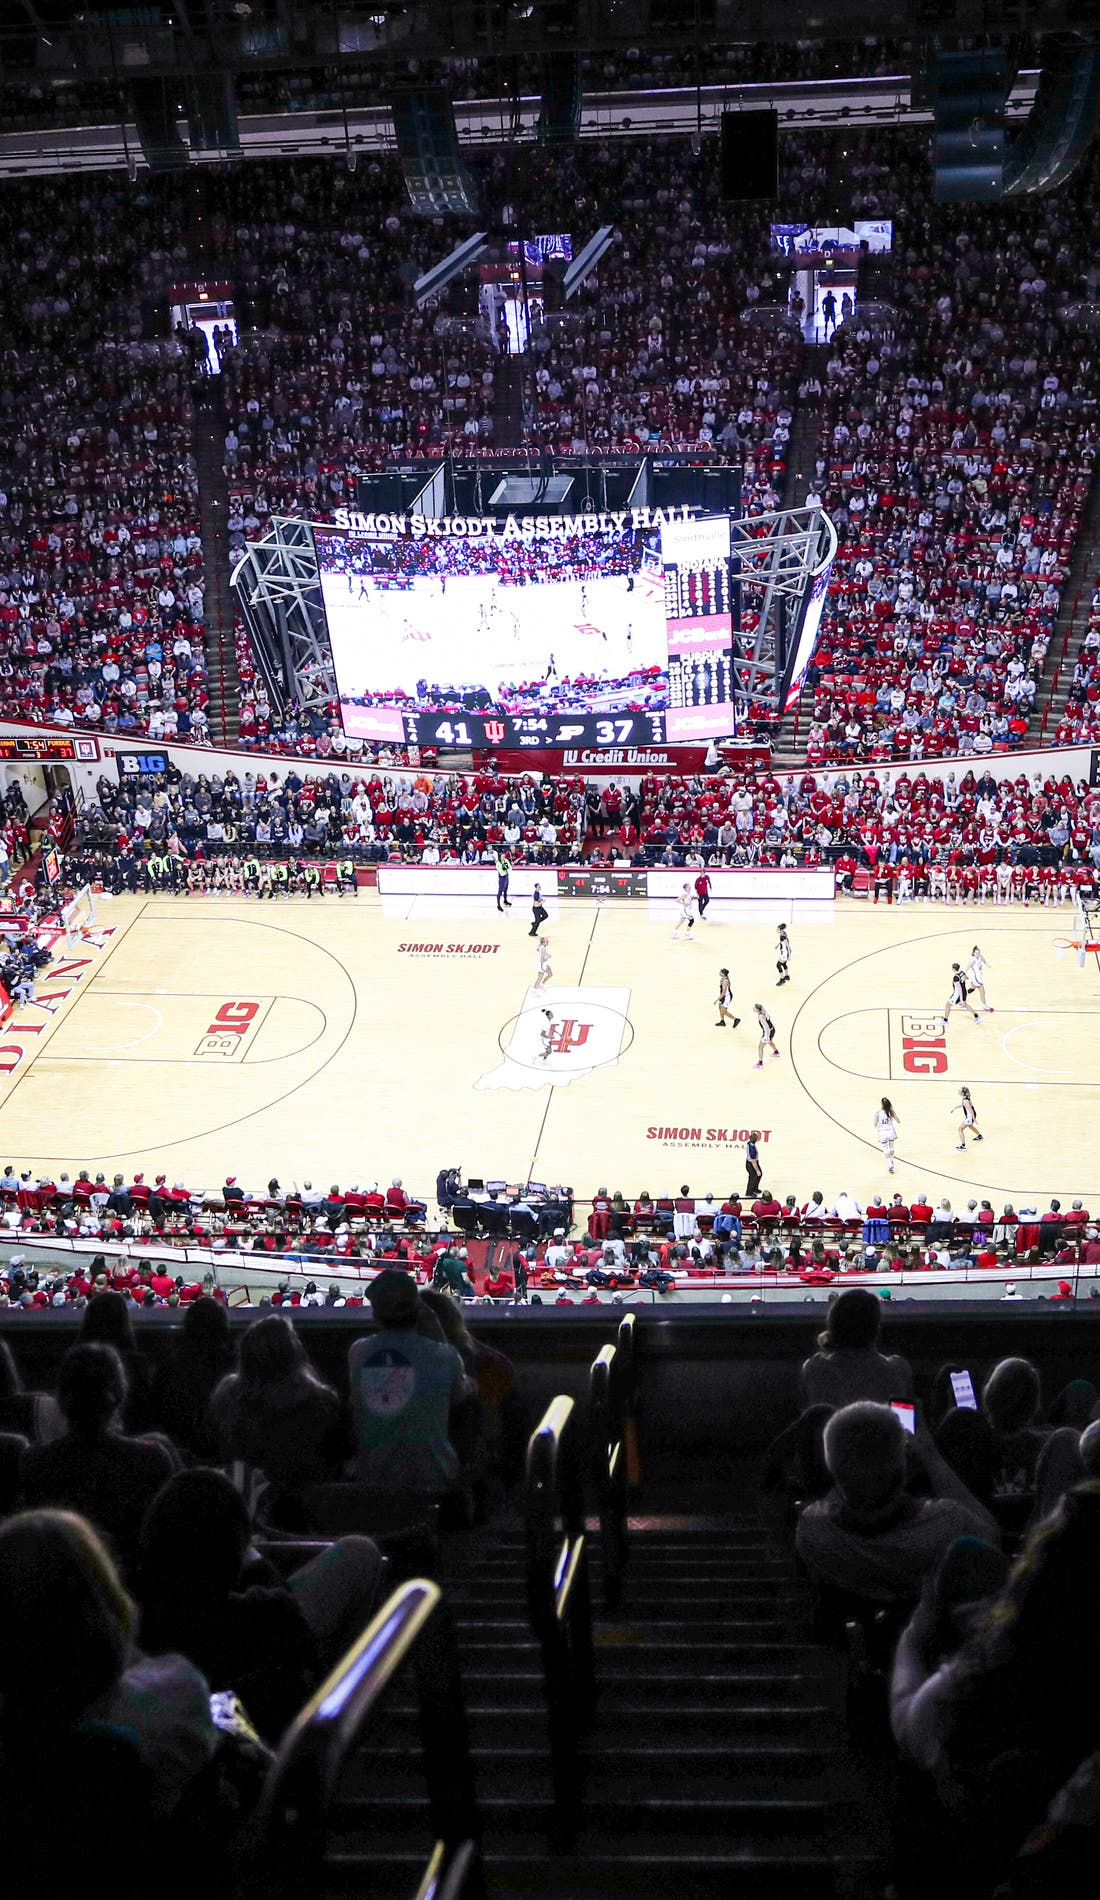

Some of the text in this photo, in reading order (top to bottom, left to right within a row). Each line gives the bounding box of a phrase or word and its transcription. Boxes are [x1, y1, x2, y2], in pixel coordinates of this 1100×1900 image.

[335, 504, 696, 539] SIMON SKJODT ASSEMBLY HALL
[512, 718, 548, 731] 7:54
[435, 721, 473, 744] 41
[596, 720, 634, 744] 37
[24, 741, 45, 750] 7:54
[519, 736, 540, 746] 3RD
[60, 748, 73, 757] 37
[563, 749, 668, 763] IU Credit Union
[591, 885, 610, 894] 7:54
[397, 943, 501, 953] SIMON SKJODT
[646, 1127, 702, 1140] SIMON
